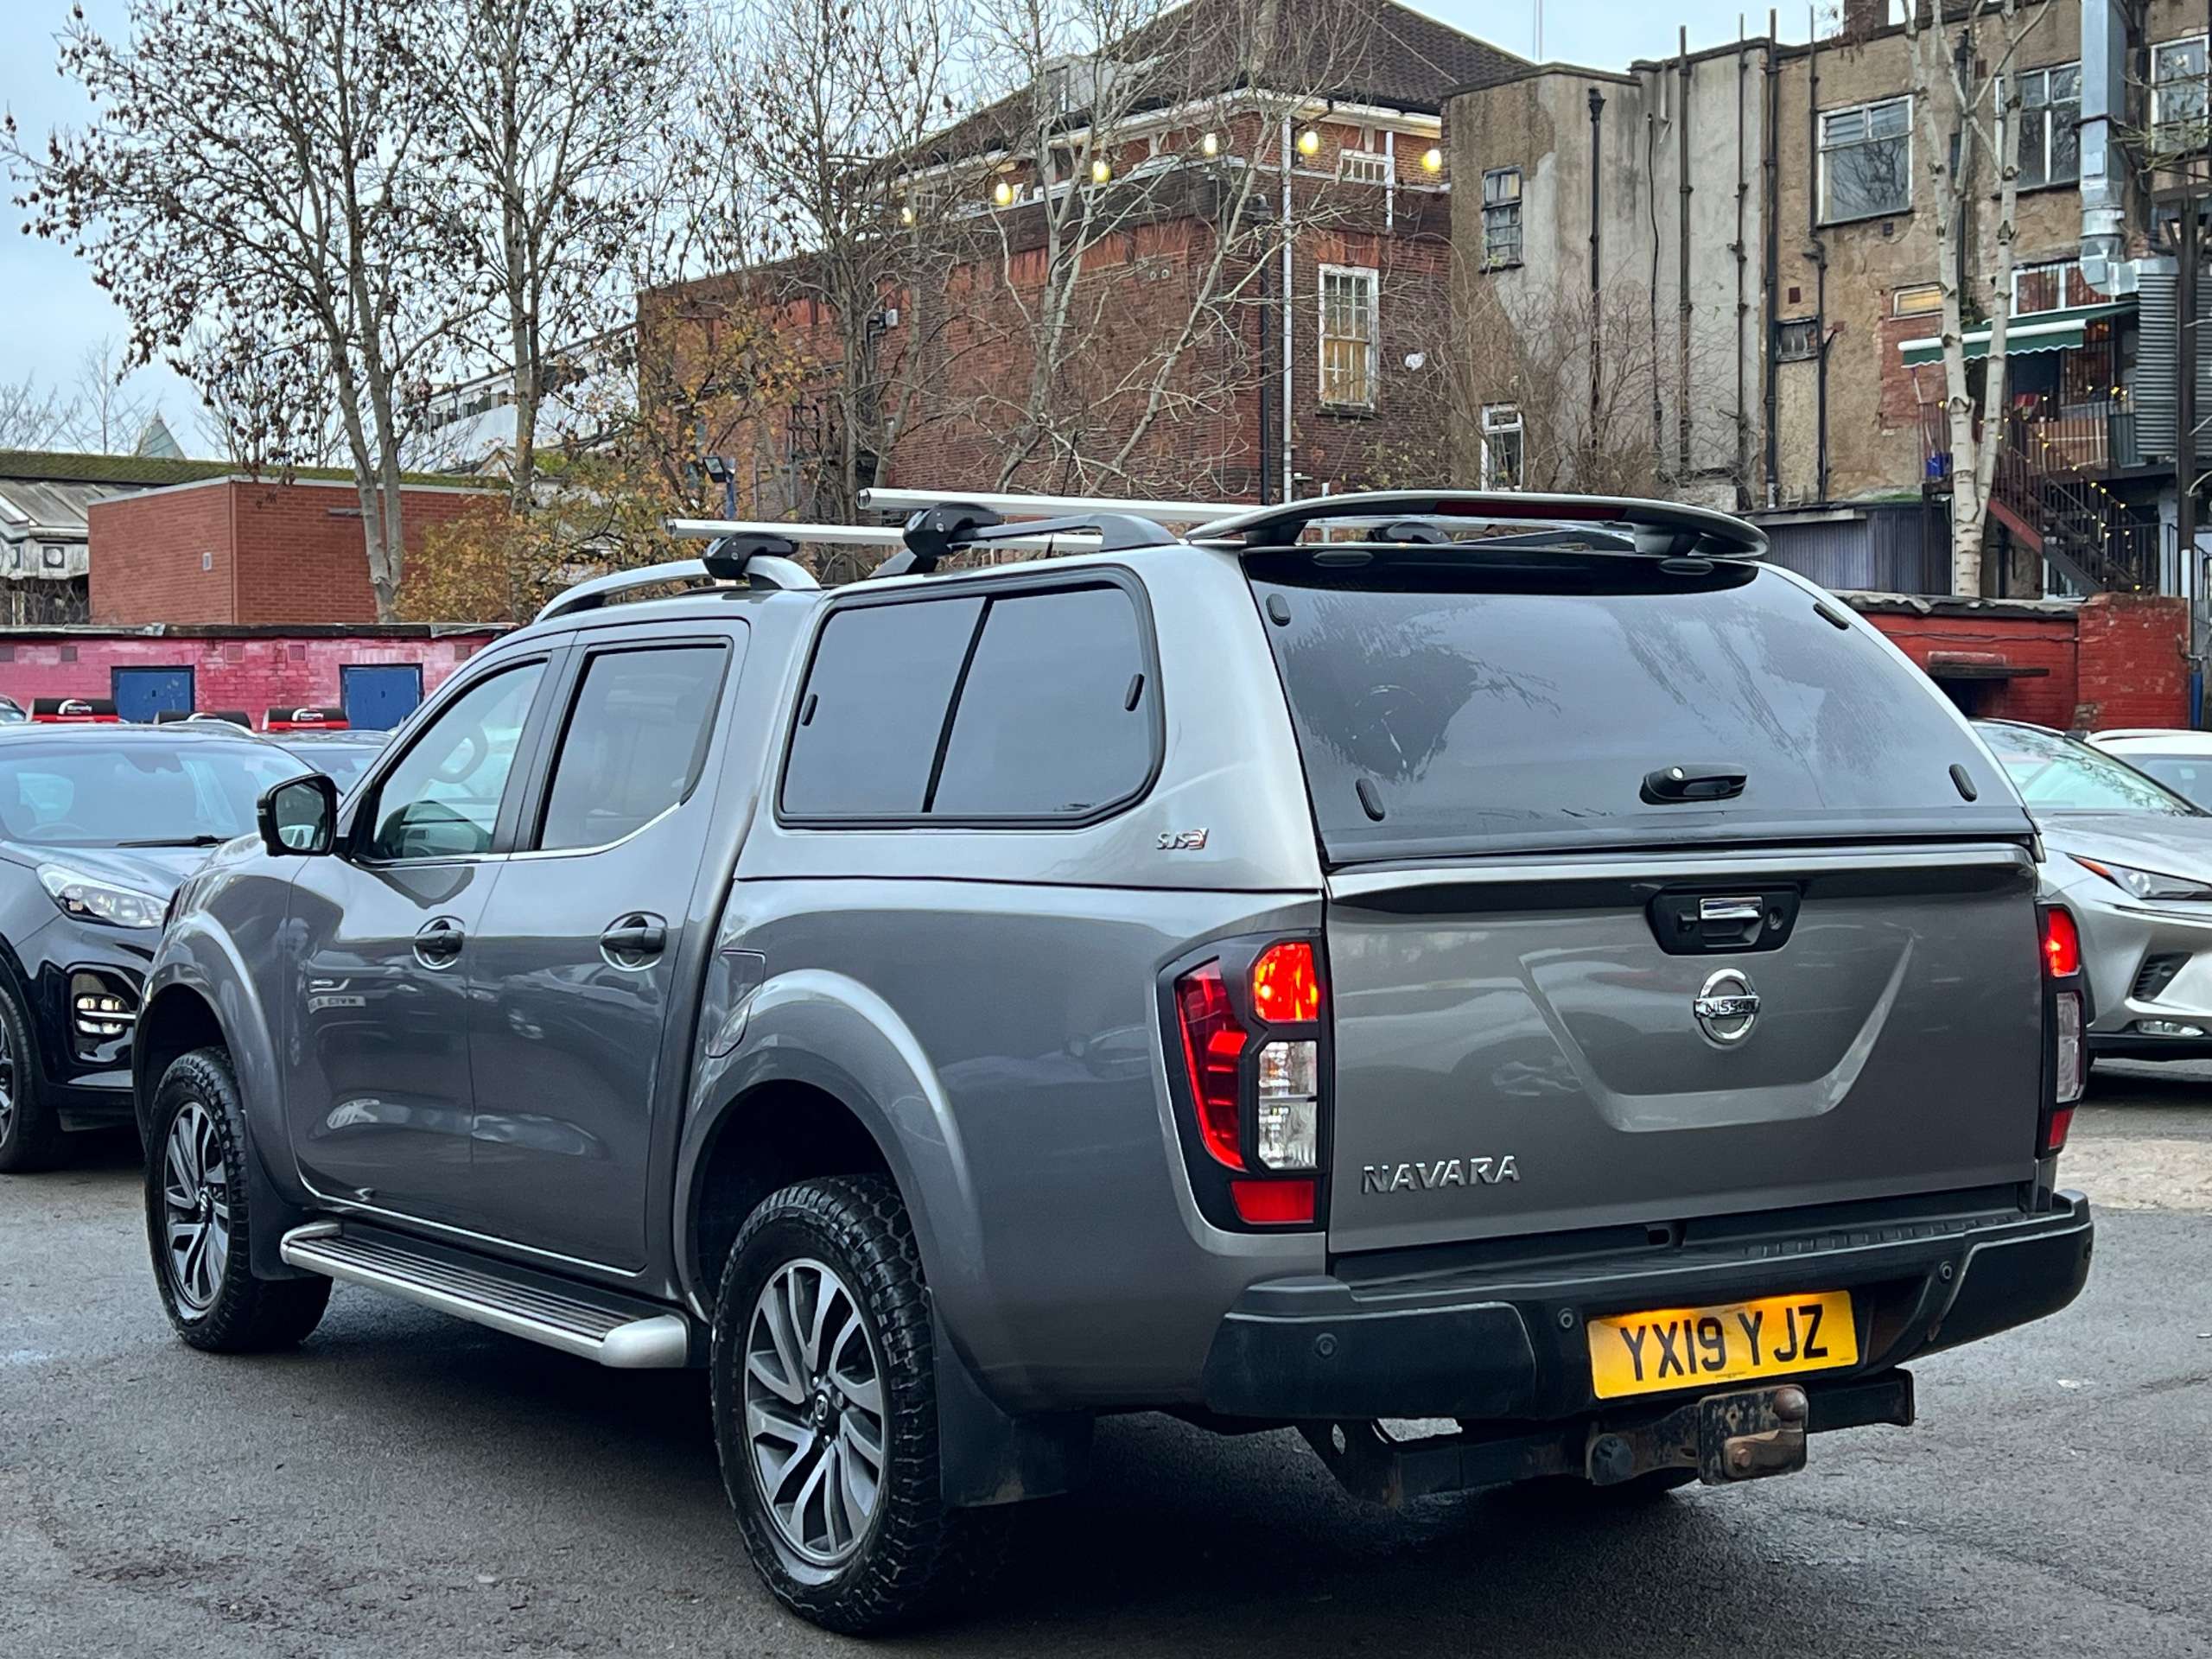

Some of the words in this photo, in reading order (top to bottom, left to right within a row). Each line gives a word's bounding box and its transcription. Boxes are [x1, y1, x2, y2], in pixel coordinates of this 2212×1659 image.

[1362, 1155, 1521, 1194] NAVARA
[1619, 1316, 1726, 1382] YX19
[1737, 1303, 1828, 1366] YJZ
